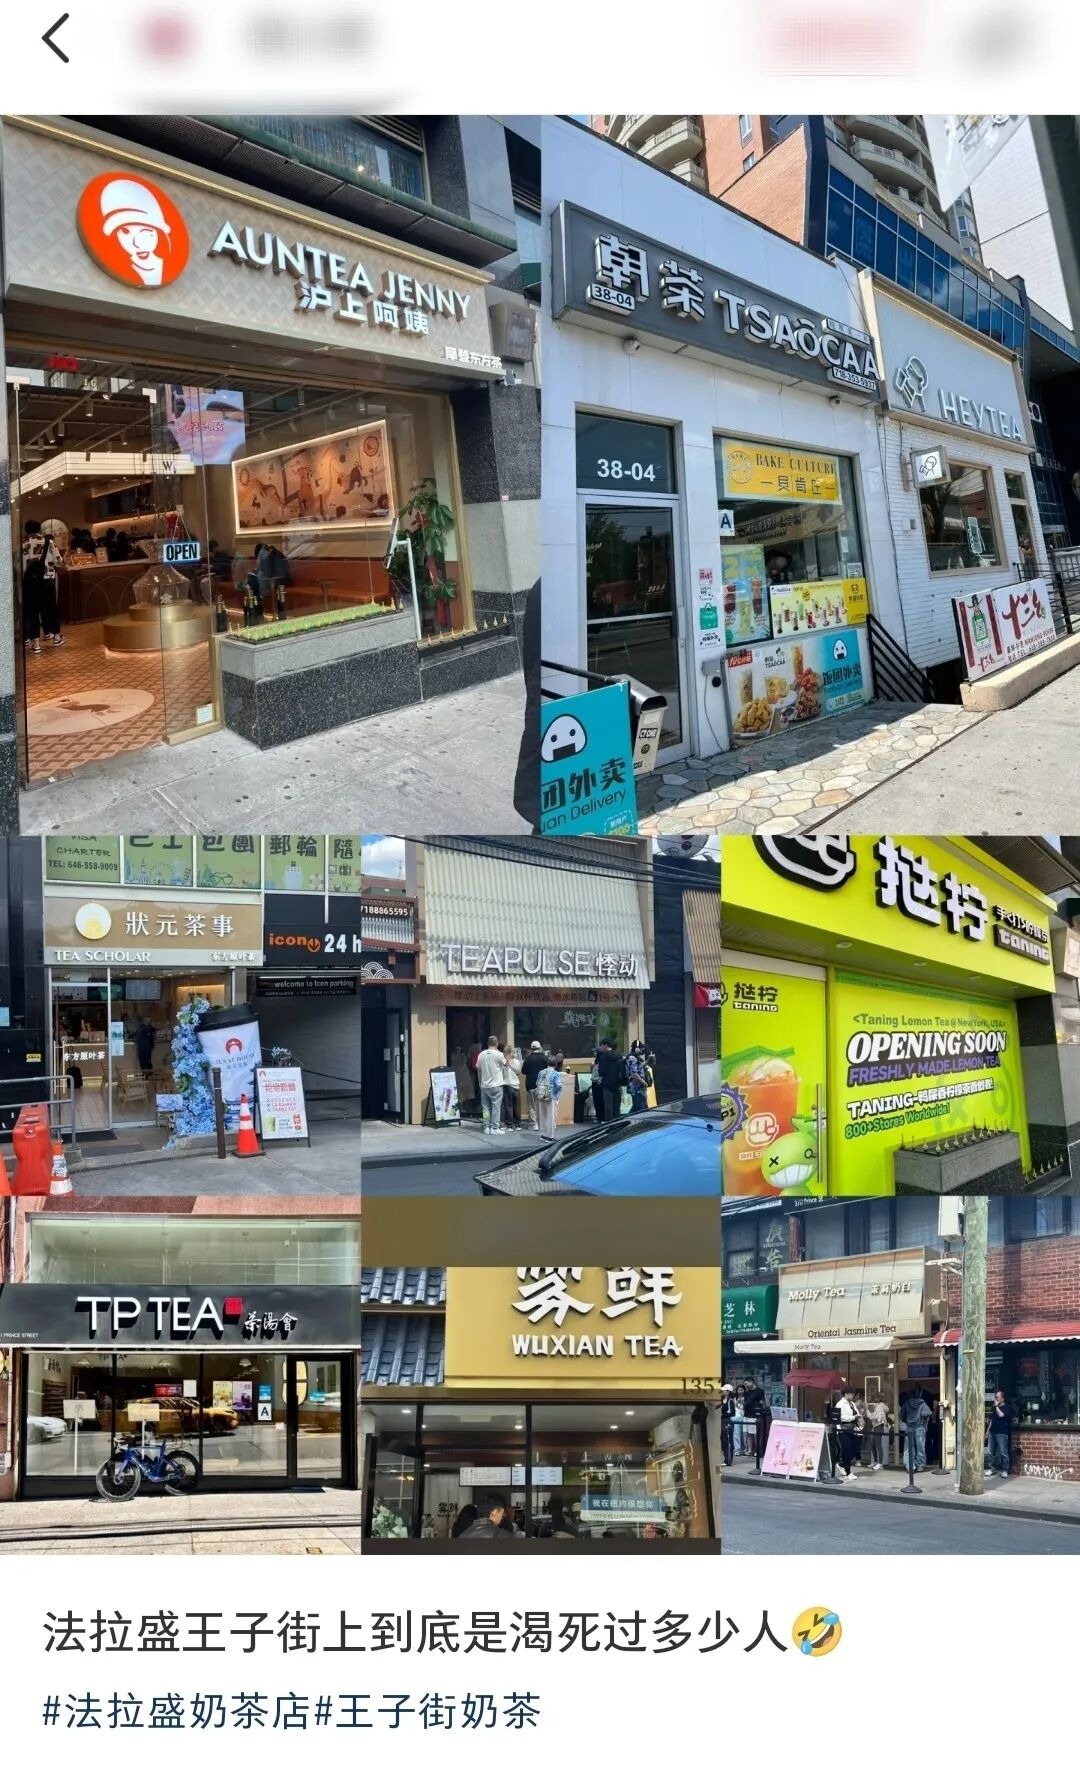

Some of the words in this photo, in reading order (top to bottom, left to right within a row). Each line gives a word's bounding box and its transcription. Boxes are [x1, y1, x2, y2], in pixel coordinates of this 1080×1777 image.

[209, 220, 374, 293] AUNTEA
[382, 269, 472, 320] JENNY
[594, 285, 632, 308] 38-04
[299, 281, 430, 336] 沪上阿姨
[939, 389, 1023, 442] HEYTEA
[596, 458, 656, 482] 38-04
[756, 453, 784, 469] BAKE
[789, 458, 836, 475] CULTURE
[720, 513, 732, 529] A
[165, 542, 198, 562] OPEN
[570, 788, 626, 821] Delivery
[56, 847, 112, 857] CHARTER
[48, 859, 66, 868] TEL:
[67, 860, 118, 871] 646-558-9009
[125, 911, 234, 939] 狀元茶事
[269, 932, 308, 946] icon
[324, 933, 348, 953] 24
[55, 950, 80, 962] TEA
[85, 950, 151, 962] SCHOLAR
[439, 943, 591, 977] TEAPULSE
[595, 951, 639, 978] 悸动
[274, 980, 305, 988] welcome
[306, 980, 313, 988] to
[330, 979, 354, 989] parking
[901, 1015, 933, 1026] Lemon
[847, 1031, 962, 1064] OPENING
[963, 1031, 1007, 1054] SOON
[850, 1063, 917, 1085] FRESHLY
[917, 1059, 950, 1076] MADE
[953, 1056, 984, 1070] LEMON
[985, 1054, 1002, 1067] TEA
[844, 1114, 904, 1138] 800+Stores
[905, 1103, 950, 1123] Worldwide!
[788, 1288, 820, 1301] Molly
[824, 1286, 846, 1297] Tea
[76, 1296, 142, 1331] TP
[149, 1296, 224, 1331] TEA
[723, 1301, 756, 1317] 芝林
[244, 1310, 298, 1332] 茶湯會
[808, 1328, 841, 1338] Oriental
[844, 1324, 878, 1336] Jasmine
[880, 1324, 897, 1333] Tea
[512, 1335, 614, 1357] WUXIAN
[624, 1335, 683, 1357] TEA
[261, 1406, 269, 1416] A
